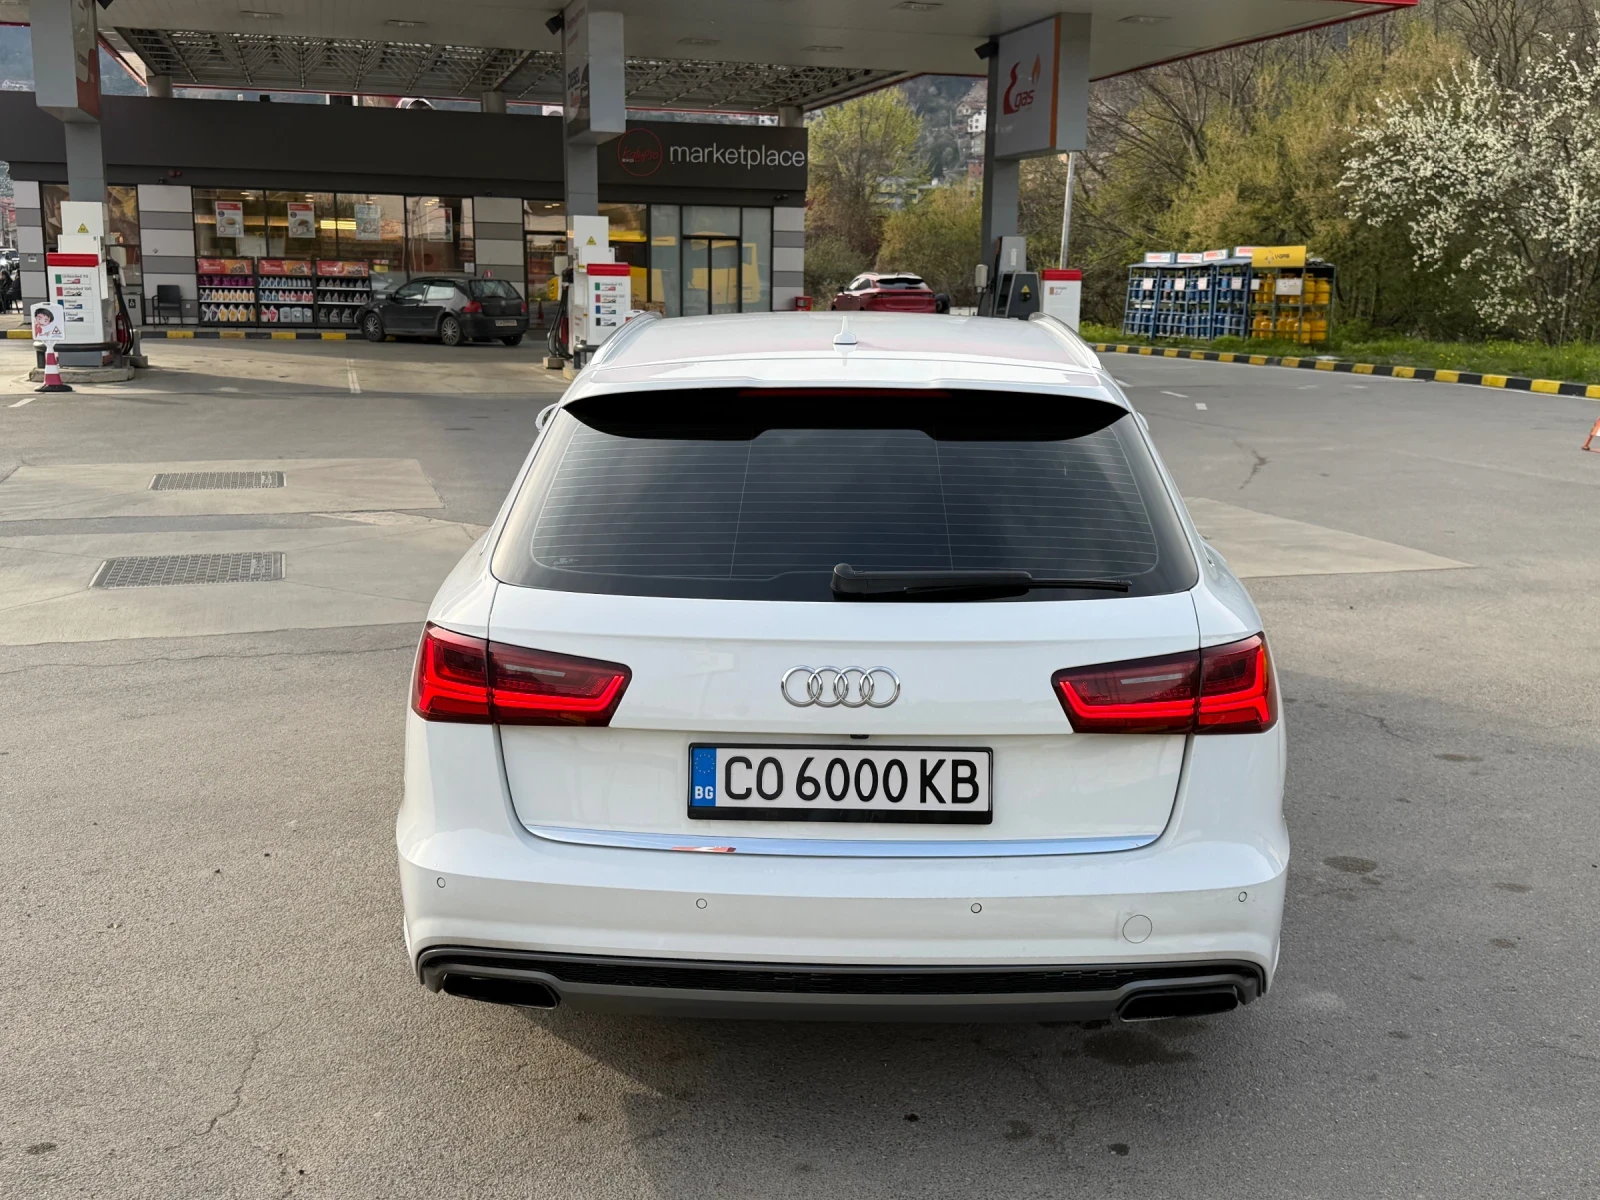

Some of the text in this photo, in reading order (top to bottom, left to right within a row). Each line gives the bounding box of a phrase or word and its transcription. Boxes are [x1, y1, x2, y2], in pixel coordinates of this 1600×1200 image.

[1014, 89, 1036, 111] gas
[670, 142, 805, 170] marketplace
[724, 756, 980, 804] CO 6000 KB
[694, 786, 714, 800] BG
